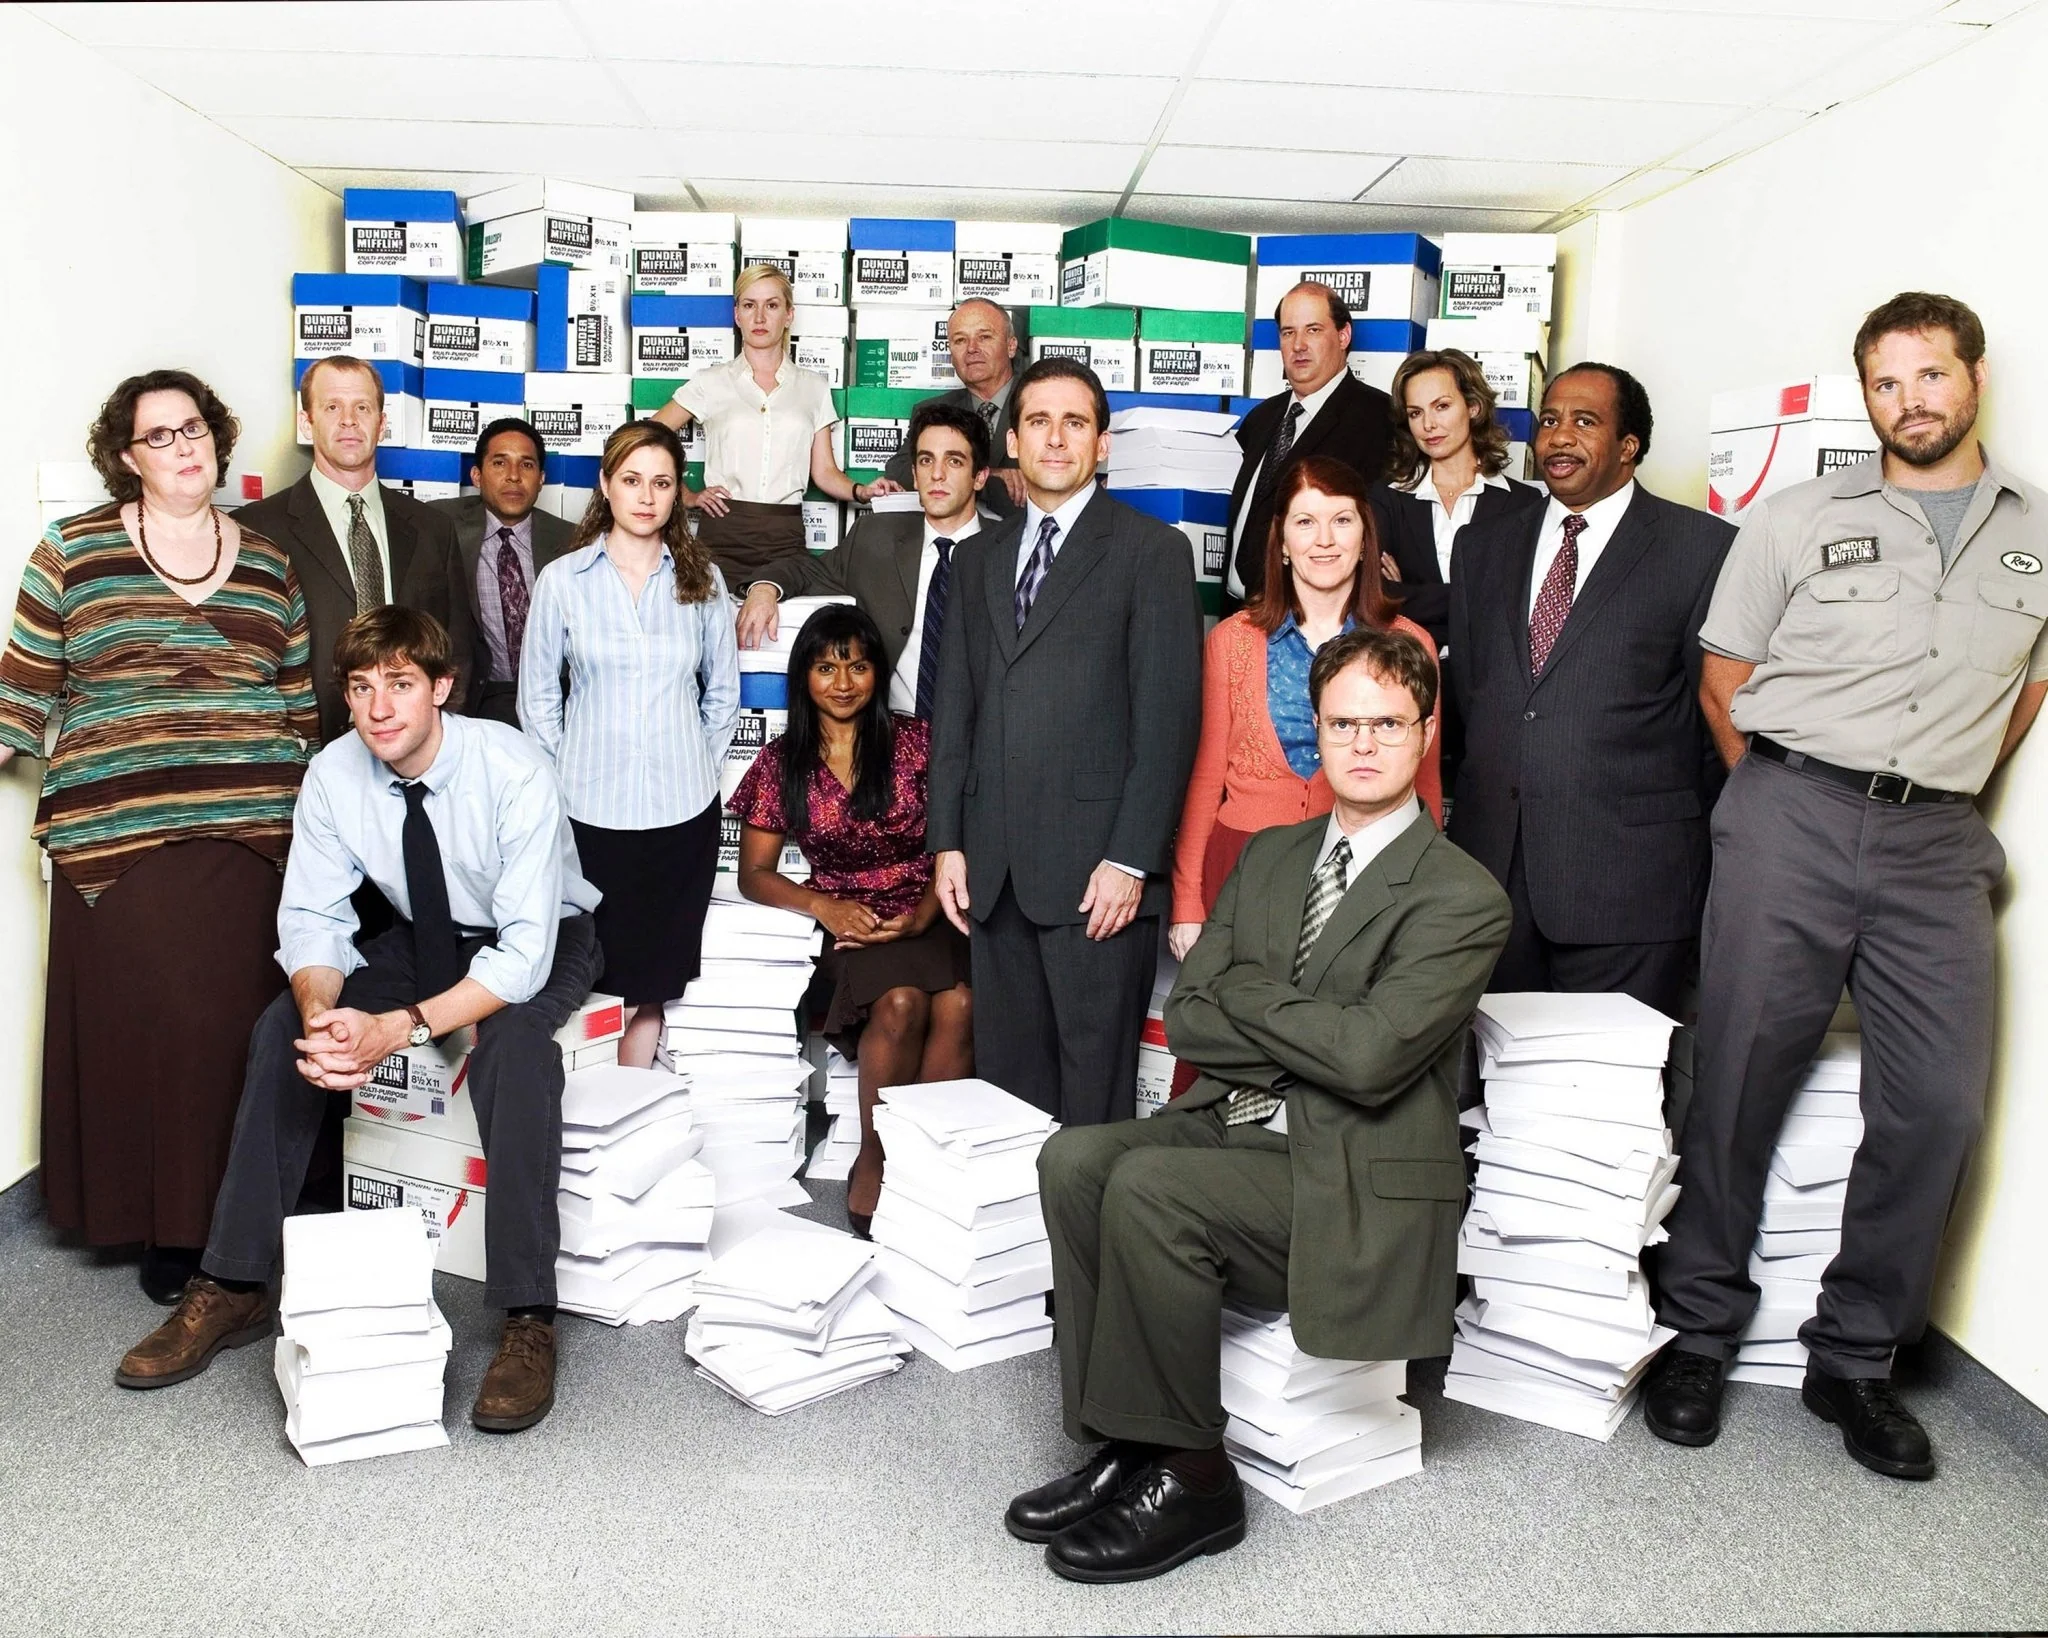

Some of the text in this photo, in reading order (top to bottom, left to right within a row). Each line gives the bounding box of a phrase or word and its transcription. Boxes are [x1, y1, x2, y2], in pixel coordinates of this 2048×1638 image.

[552, 220, 588, 234] DUNDER
[357, 229, 401, 239] DUNDER
[641, 251, 682, 260] DUNDER
[863, 260, 903, 269] DUNDER
[964, 261, 1005, 270] DUNDER
[1455, 275, 1500, 284] DUNDER
[305, 315, 346, 325] DUNDER
[434, 326, 475, 336] DUNDER
[578, 320, 587, 361] DUNDER
[643, 337, 684, 346] DUNDER
[1045, 347, 1086, 355] DUNDER
[1154, 351, 1196, 360] DUNDER
[434, 410, 474, 420] DUNDER
[536, 412, 577, 421] DUNDER
[856, 429, 897, 438] DUNDER
[1825, 451, 1873, 465] DUND
[1828, 540, 1871, 556] DUNDER
[1206, 552, 1224, 569] MIFF
[2011, 556, 2032, 570] Roy
[433, 1079, 440, 1087] 11
[359, 1091, 397, 1103] COPY PAPER
[353, 1177, 398, 1199] DUNDER
[429, 1211, 435, 1219] 11
